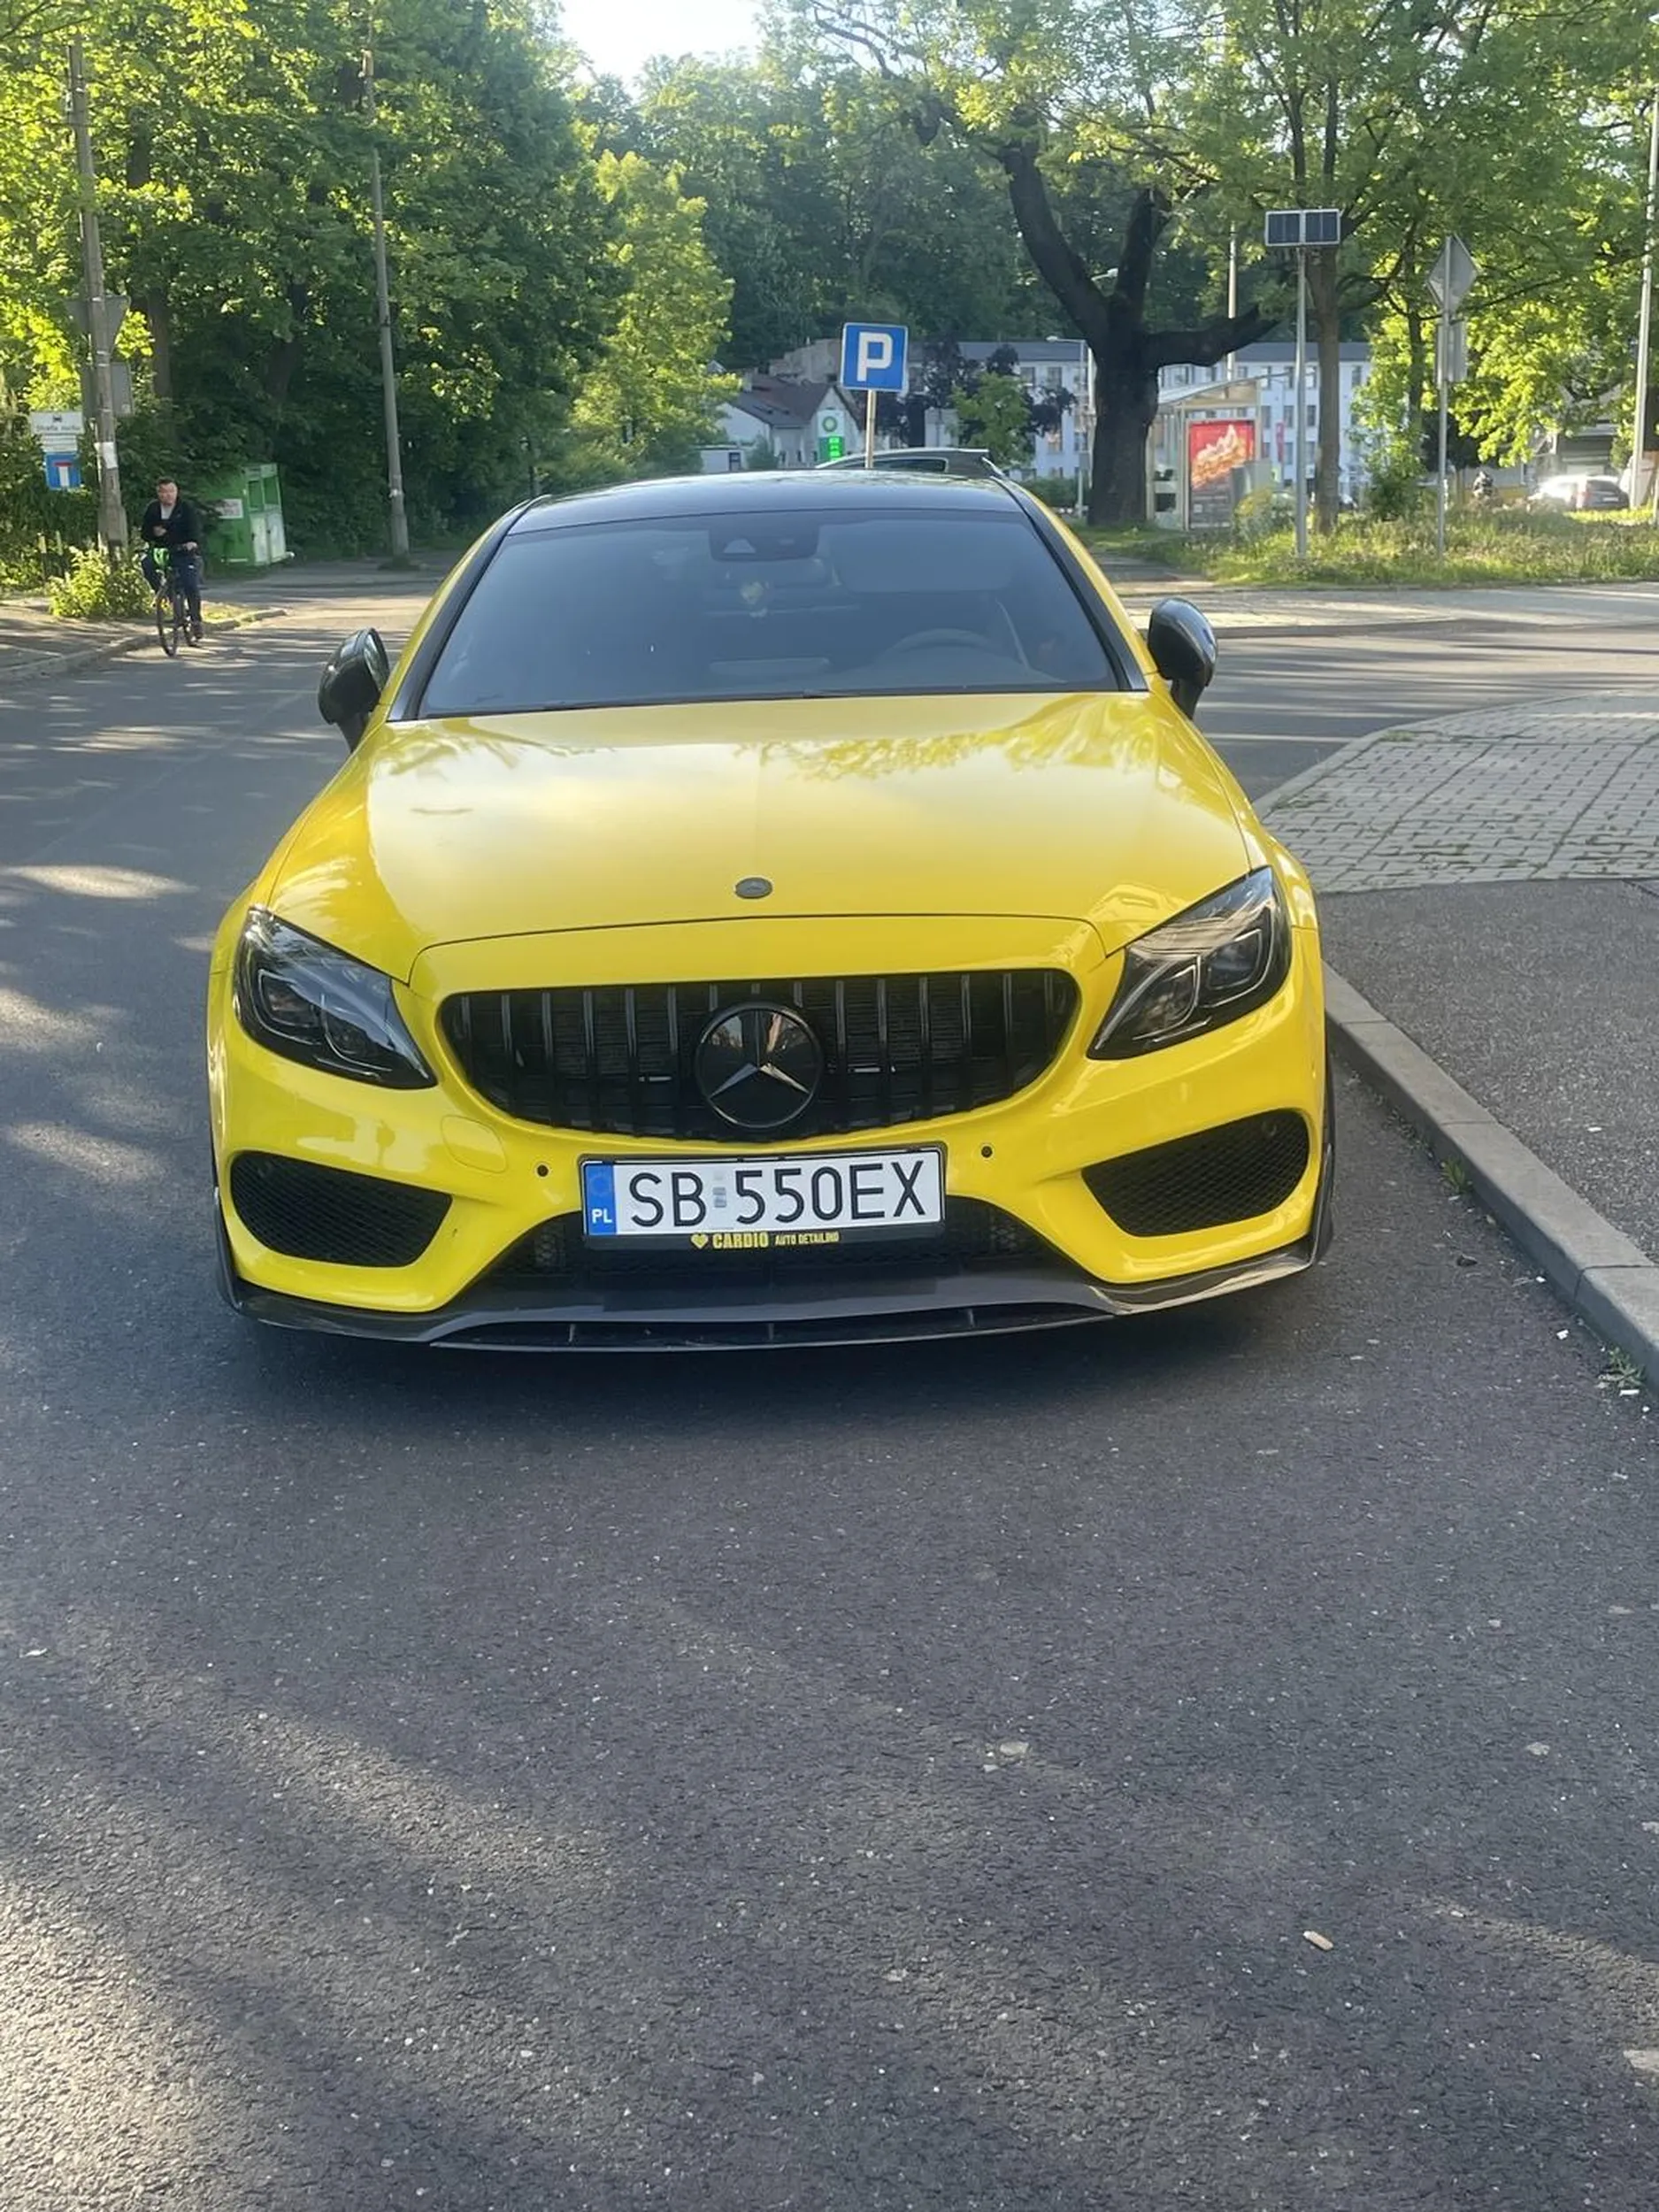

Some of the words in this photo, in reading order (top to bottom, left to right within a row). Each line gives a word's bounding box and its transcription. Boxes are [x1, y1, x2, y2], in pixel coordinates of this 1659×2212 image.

[856, 331, 893, 381] P
[629, 1171, 706, 1227] SB
[735, 1160, 926, 1225] 550EX
[591, 1209, 613, 1224] PL
[712, 1232, 769, 1249] CARDIO
[775, 1234, 796, 1247] AUTO
